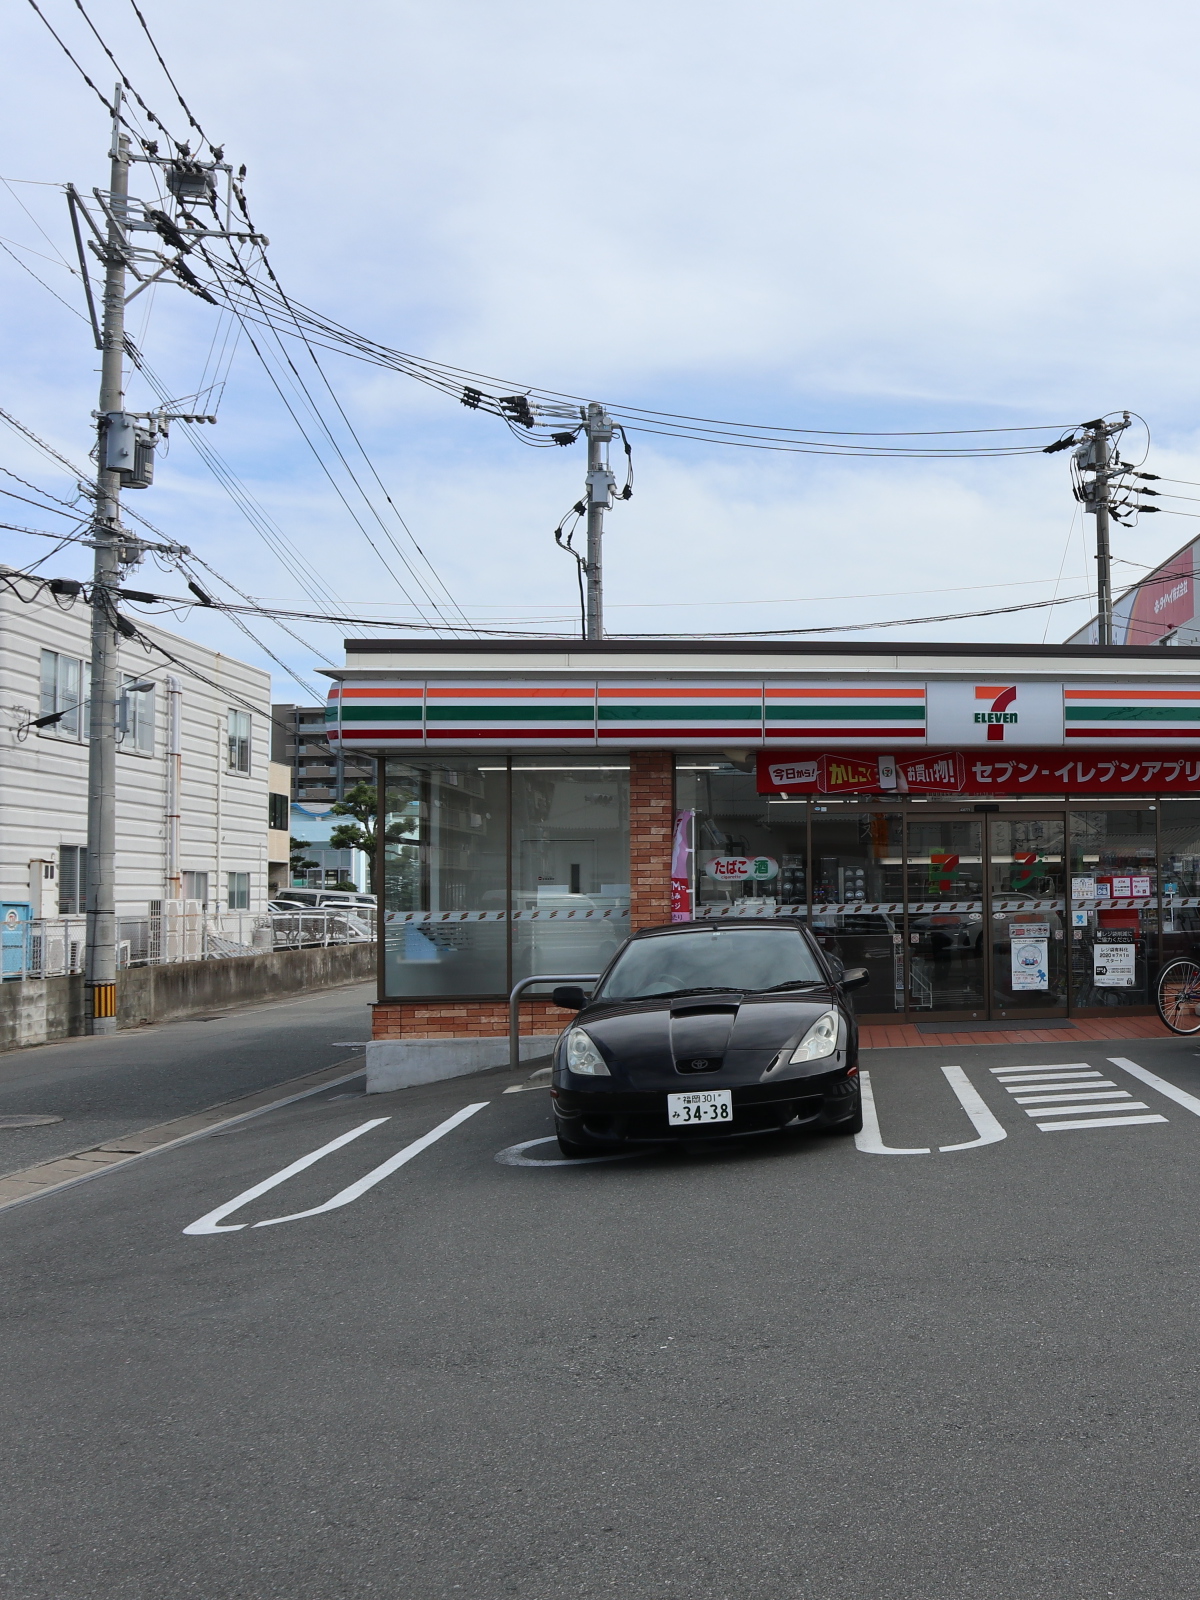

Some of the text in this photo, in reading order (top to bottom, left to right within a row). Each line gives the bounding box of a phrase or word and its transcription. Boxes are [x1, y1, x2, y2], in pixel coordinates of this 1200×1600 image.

[975, 686, 1017, 741] 7
[829, 763, 872, 785] かしこく
[907, 759, 955, 783] お買い物!
[714, 860, 769, 875] たばこ 酒
[672, 1103, 729, 1122] み 34-38
